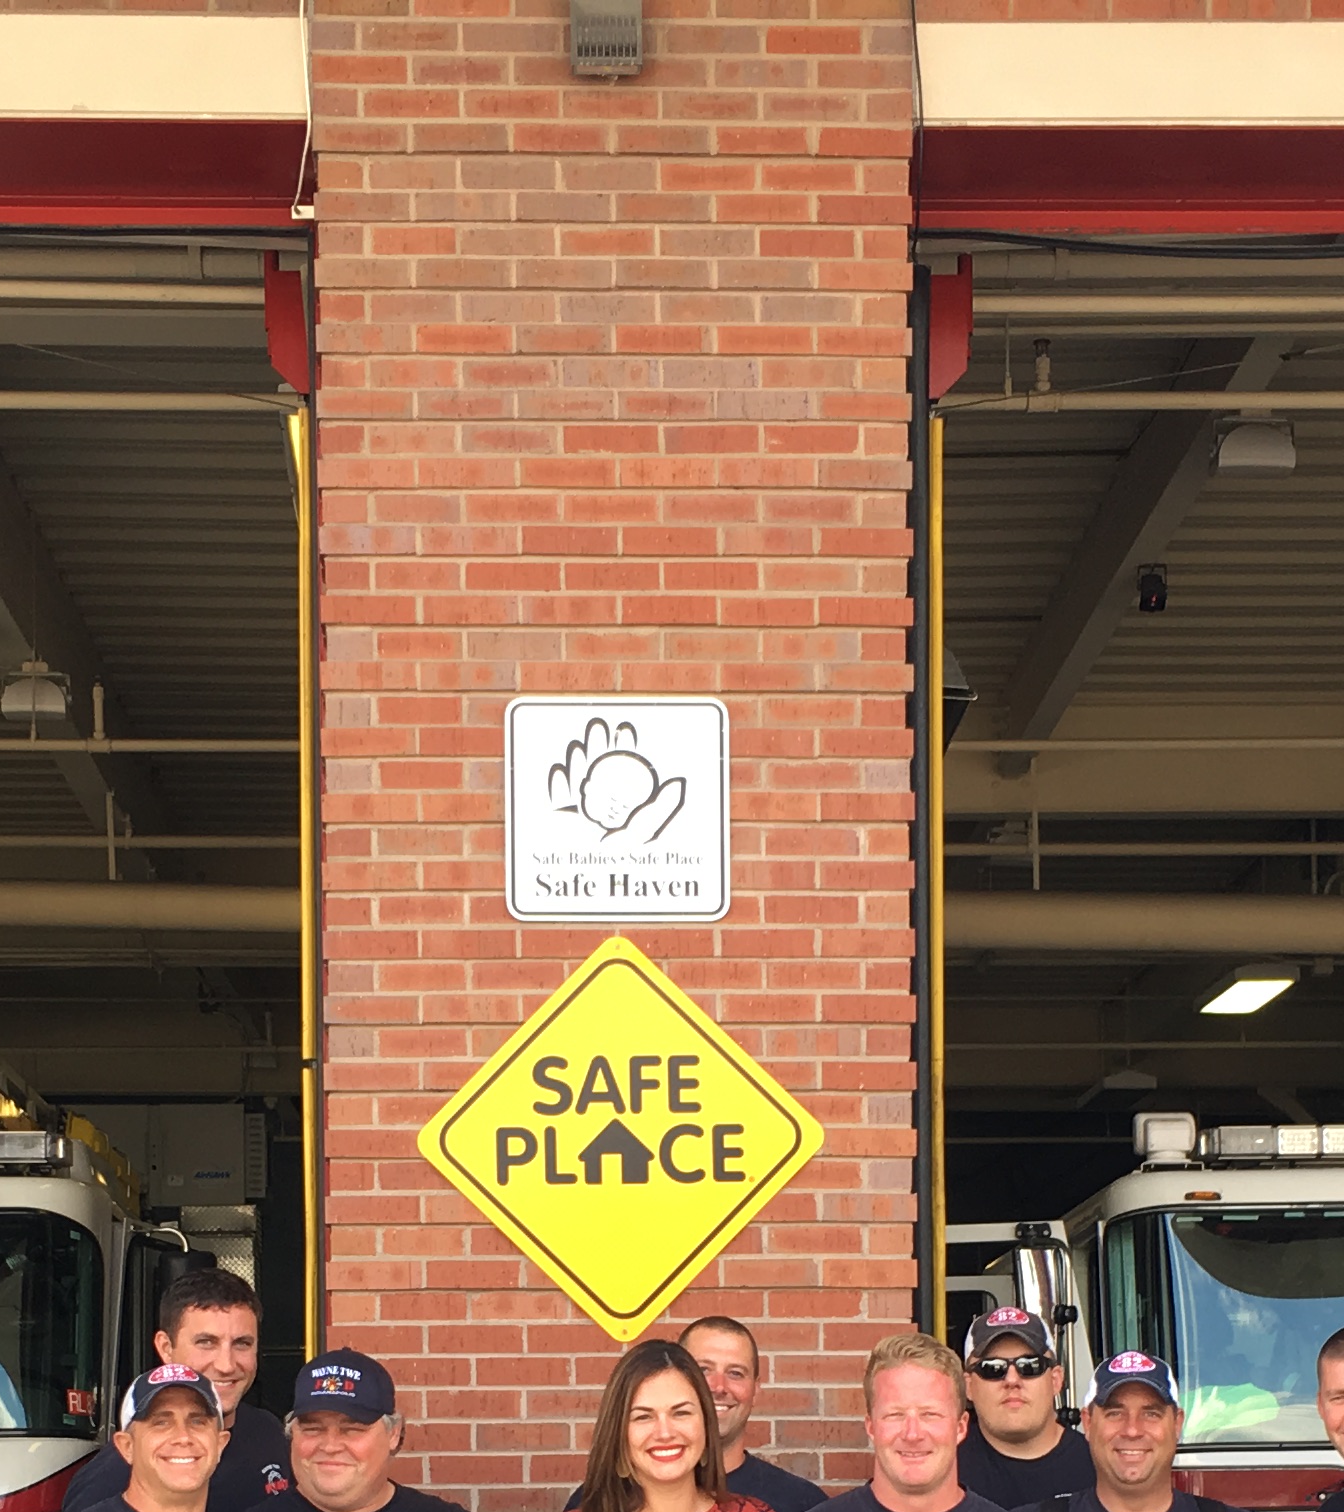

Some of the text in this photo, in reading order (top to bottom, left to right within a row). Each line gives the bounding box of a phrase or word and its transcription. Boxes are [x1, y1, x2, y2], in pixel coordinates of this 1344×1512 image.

[532, 852, 704, 865] Safe Babies Safe Place
[535, 873, 700, 898] Safe Haven
[532, 1055, 702, 1116] SAFE
